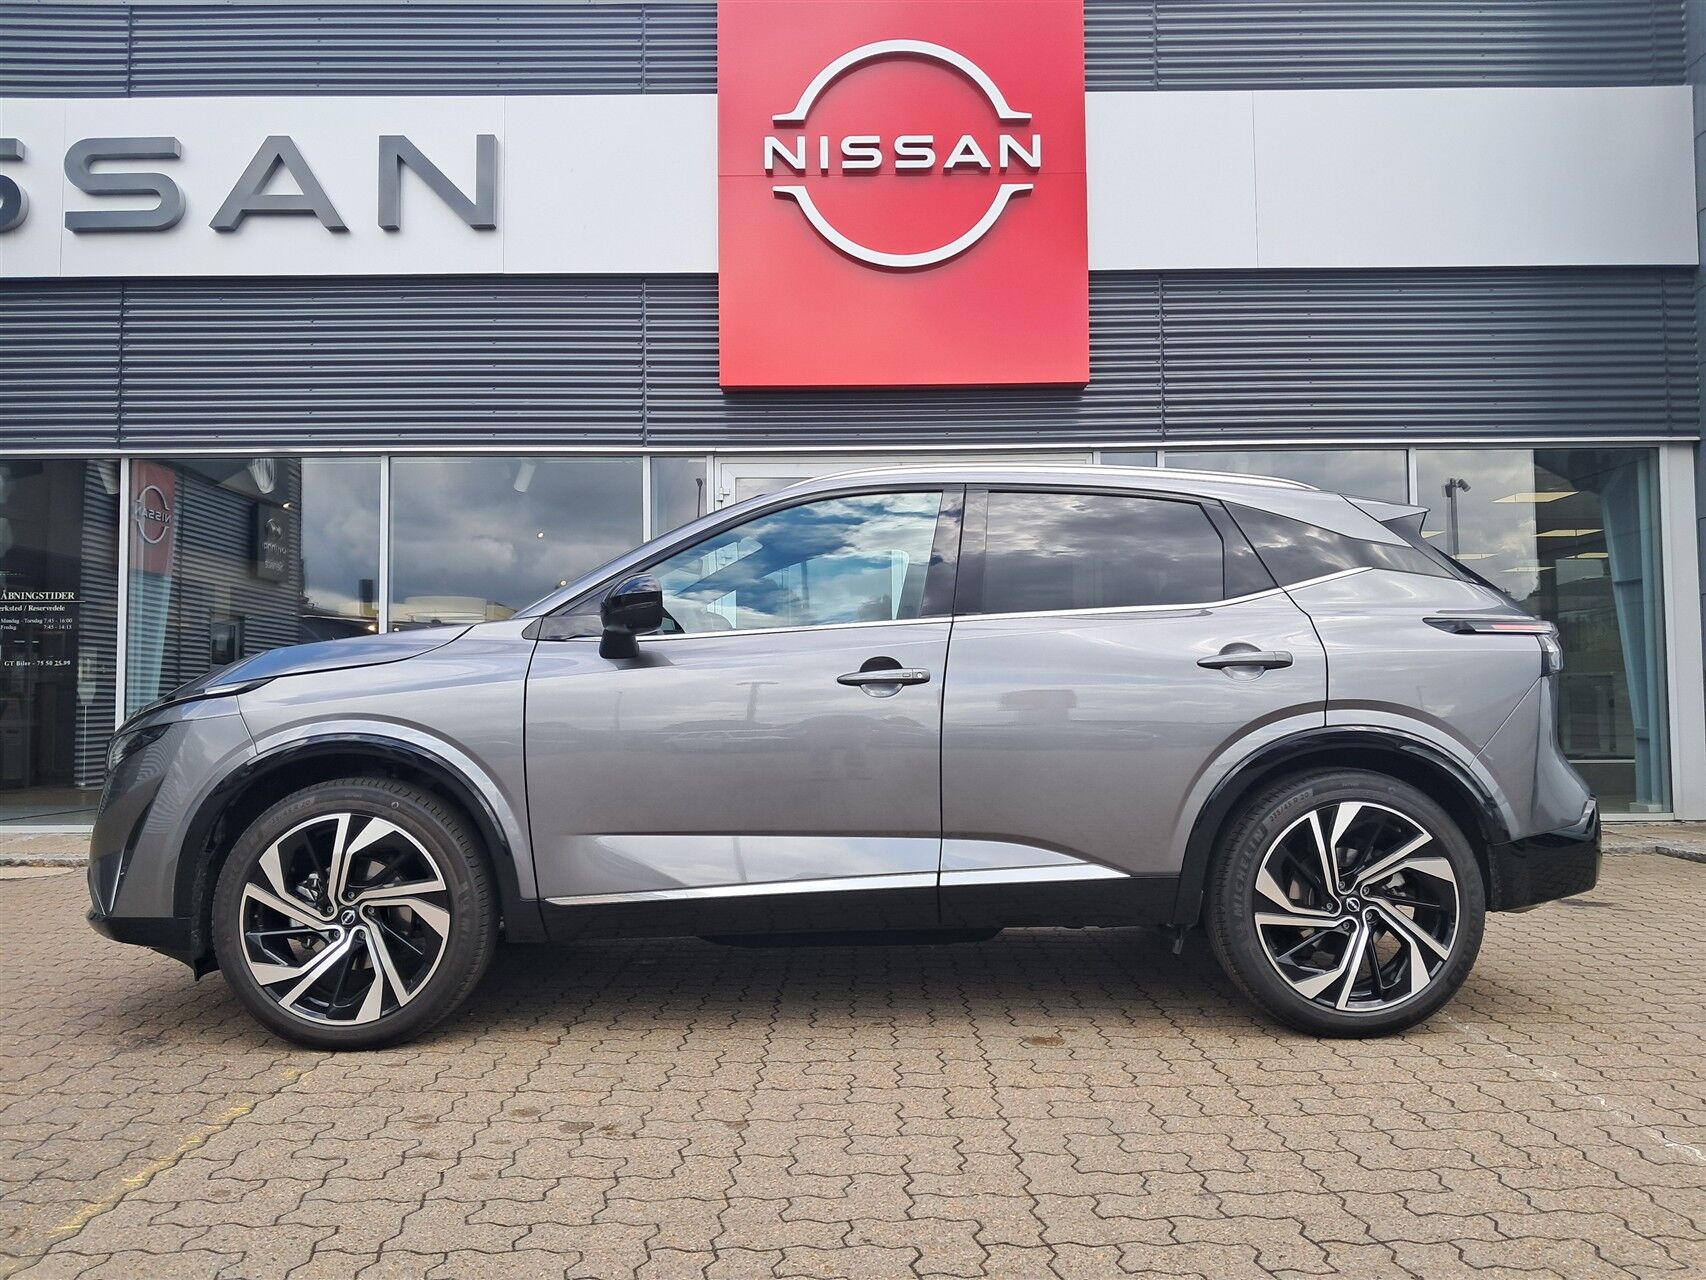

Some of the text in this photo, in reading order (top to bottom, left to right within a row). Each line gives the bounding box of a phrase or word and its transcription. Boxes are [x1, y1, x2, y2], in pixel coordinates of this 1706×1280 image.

[0, 134, 498, 233] SAN
[764, 134, 1042, 174] NISSAN
[0, 589, 75, 600] ÅBNINGSTIDER
[1233, 827, 1266, 914] MICHELIN
